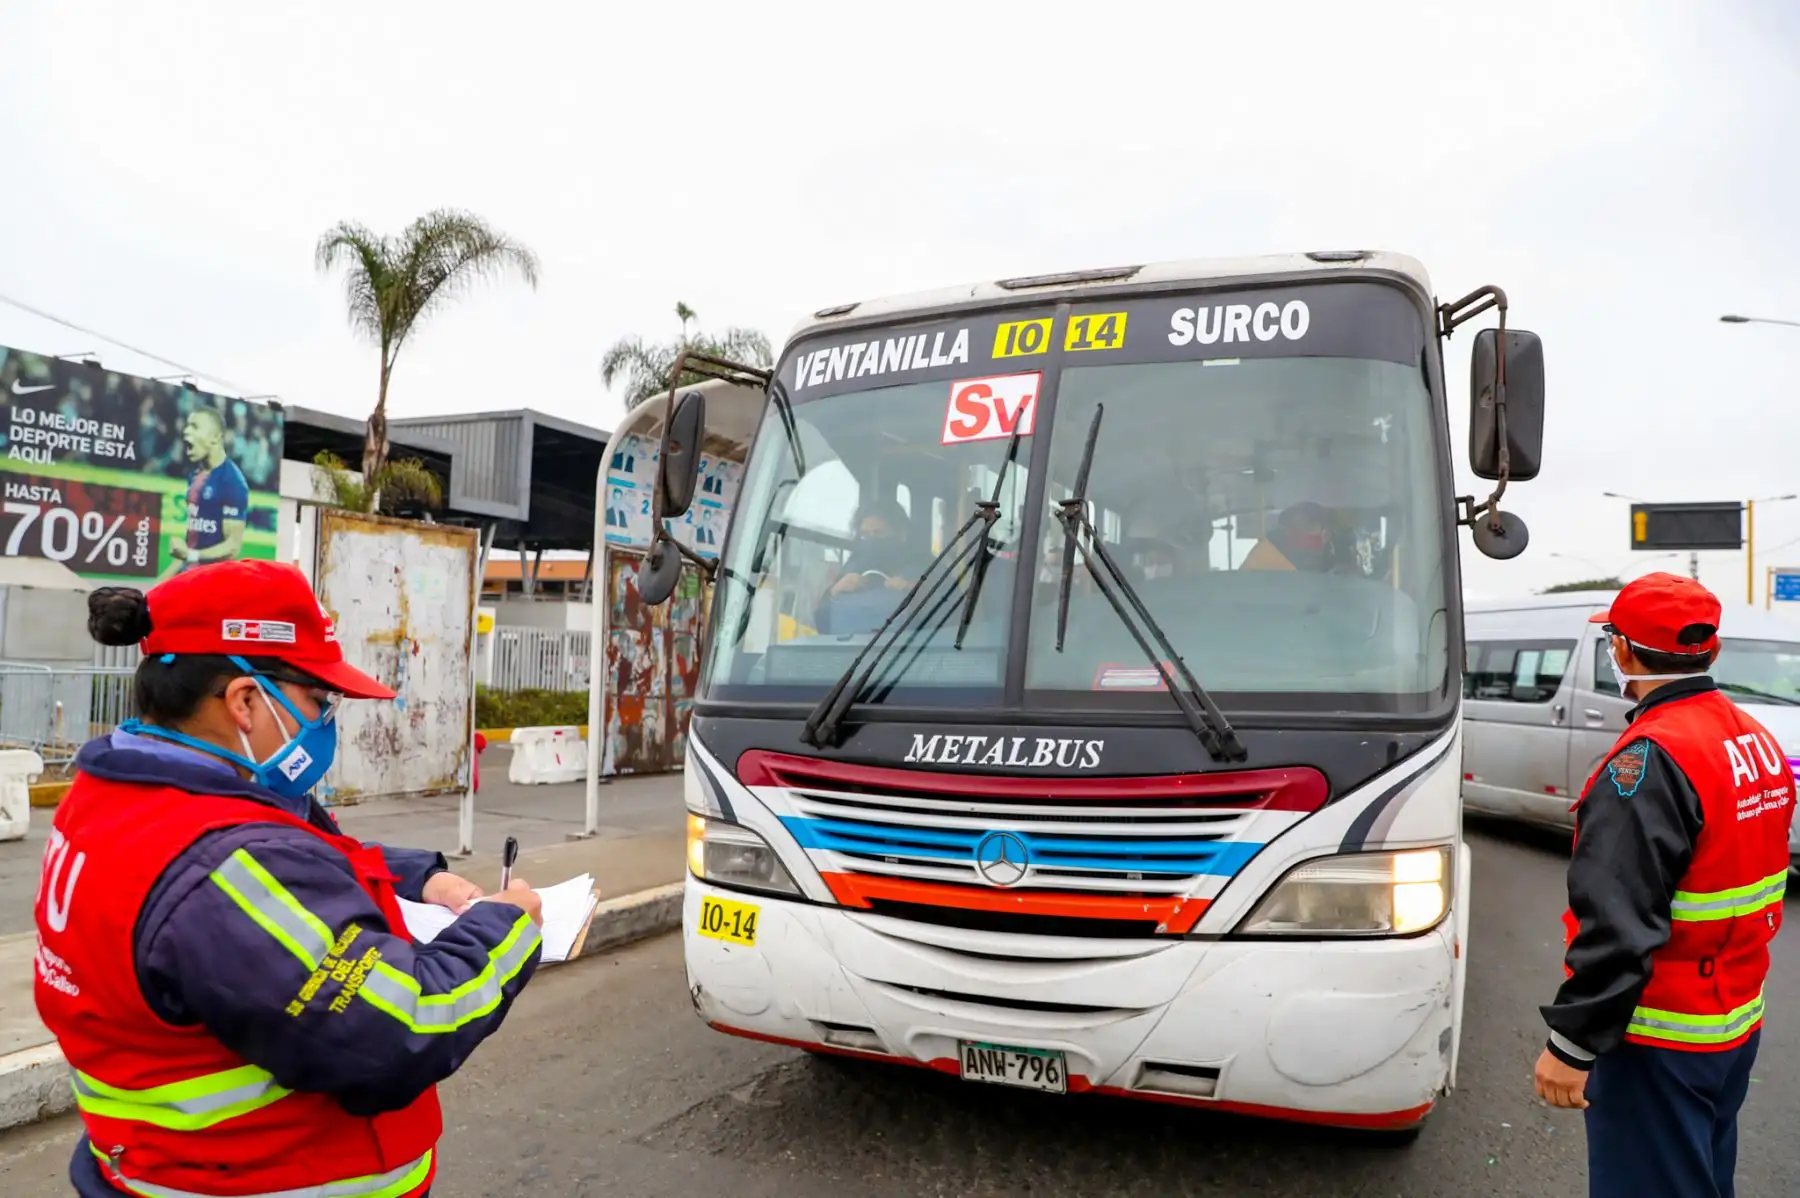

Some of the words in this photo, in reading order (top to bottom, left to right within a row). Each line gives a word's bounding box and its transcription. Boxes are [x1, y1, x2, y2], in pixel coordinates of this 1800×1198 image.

[1071, 316, 1118, 349] 14
[1168, 300, 1310, 346] SURCO
[794, 328, 969, 391] VENTANILLA
[11, 406, 36, 425] LO
[39, 411, 99, 436] MEJOR
[102, 422, 125, 441] EN
[10, 425, 91, 452] DEPORTE
[94, 440, 136, 460] ESTÁ
[5, 482, 62, 504] HASTA
[641, 500, 650, 514] 2
[3, 501, 129, 566] 70%
[132, 516, 151, 567] dscto.
[904, 734, 1104, 768] METALBUS
[1723, 732, 1781, 787] ATU
[328, 946, 382, 1013] TRANSPORTE
[330, 959, 357, 982] DEL
[966, 1047, 1059, 1085] ANW-796
